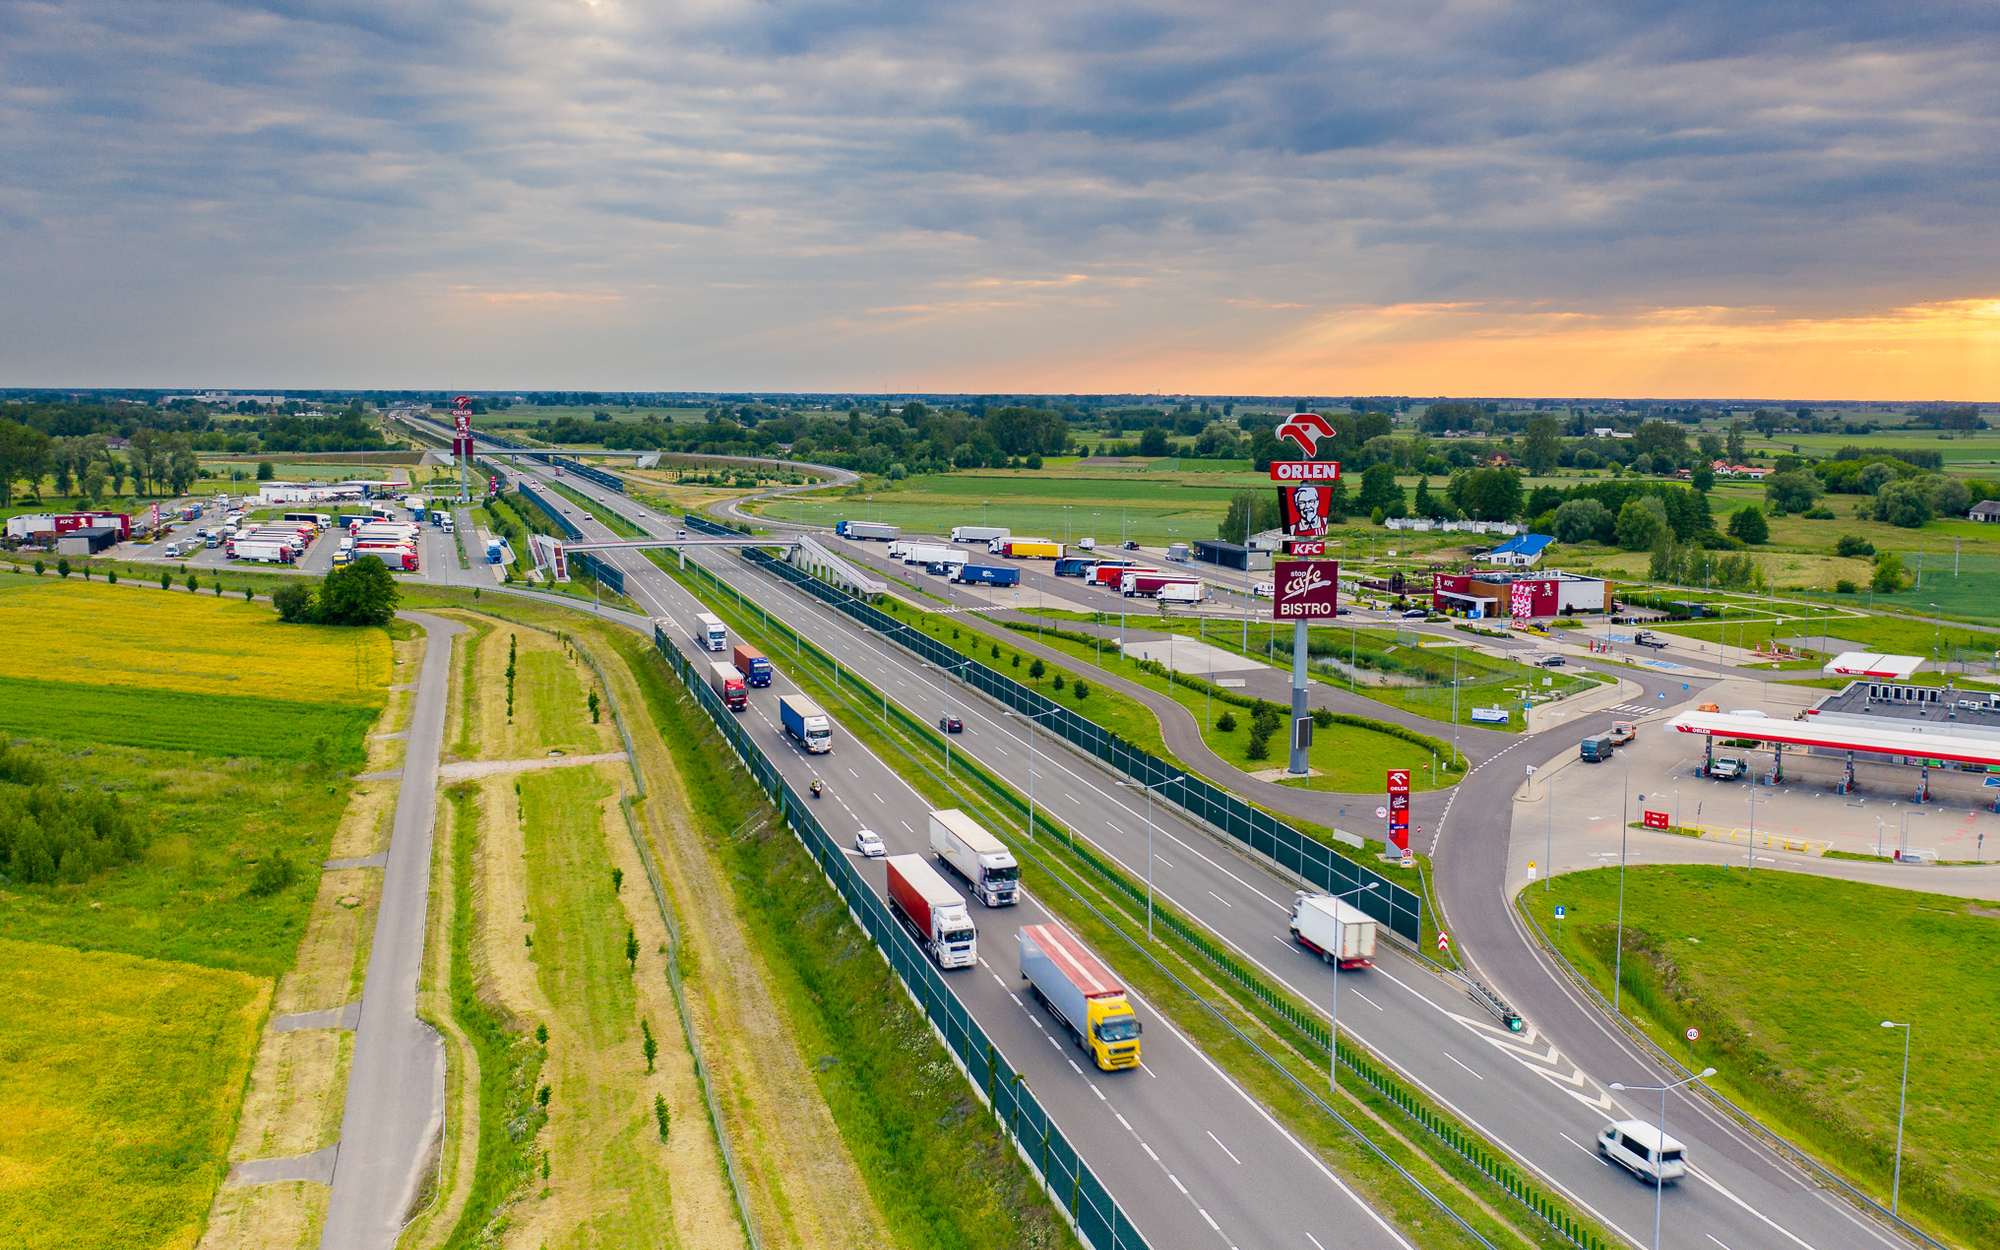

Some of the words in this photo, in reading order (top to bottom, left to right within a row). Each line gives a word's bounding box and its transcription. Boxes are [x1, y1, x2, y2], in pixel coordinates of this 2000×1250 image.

[1277, 464, 1336, 479] ORLEN
[1293, 543, 1323, 554] KFC
[1284, 563, 1322, 597] cafe
[1280, 603, 1331, 615] BISTRO
